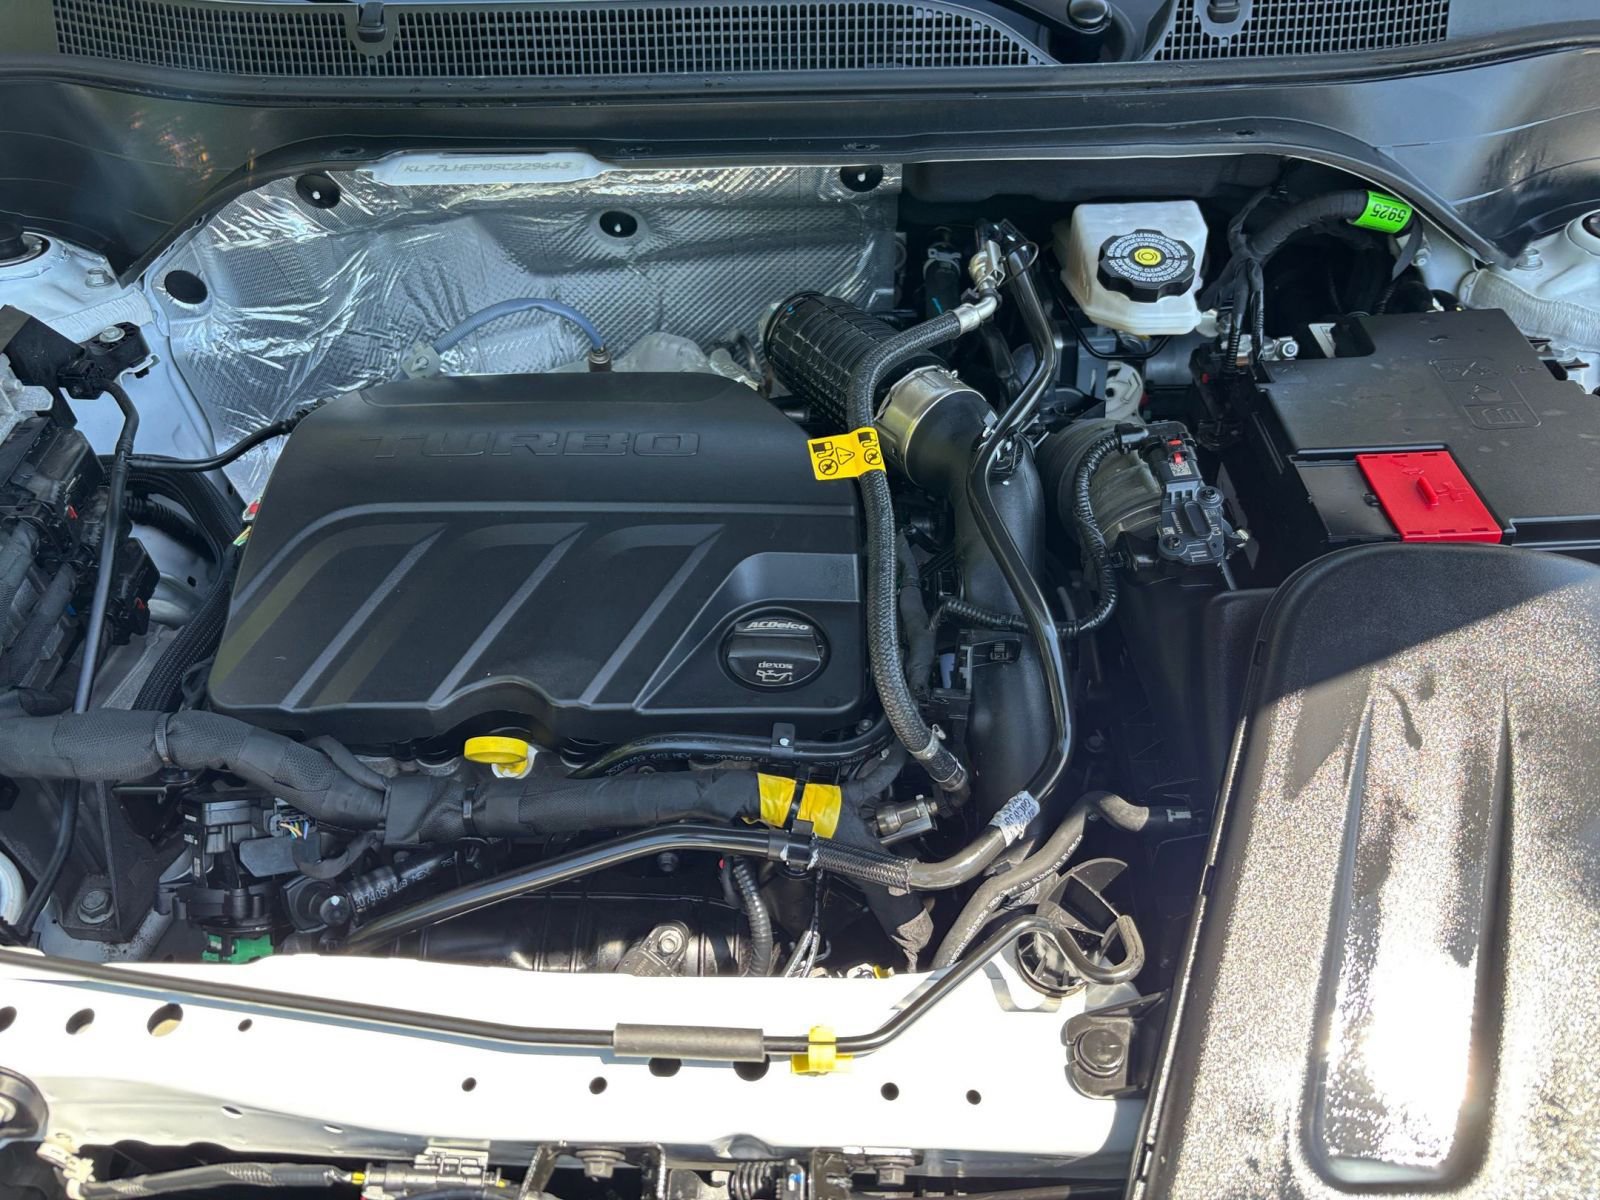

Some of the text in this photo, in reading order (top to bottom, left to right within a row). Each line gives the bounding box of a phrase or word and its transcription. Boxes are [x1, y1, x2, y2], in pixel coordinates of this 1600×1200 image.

[1370, 204, 1406, 222] 5925
[361, 431, 701, 458] TURBO
[744, 622, 809, 630] ACDelco
[758, 661, 794, 669] dexos
